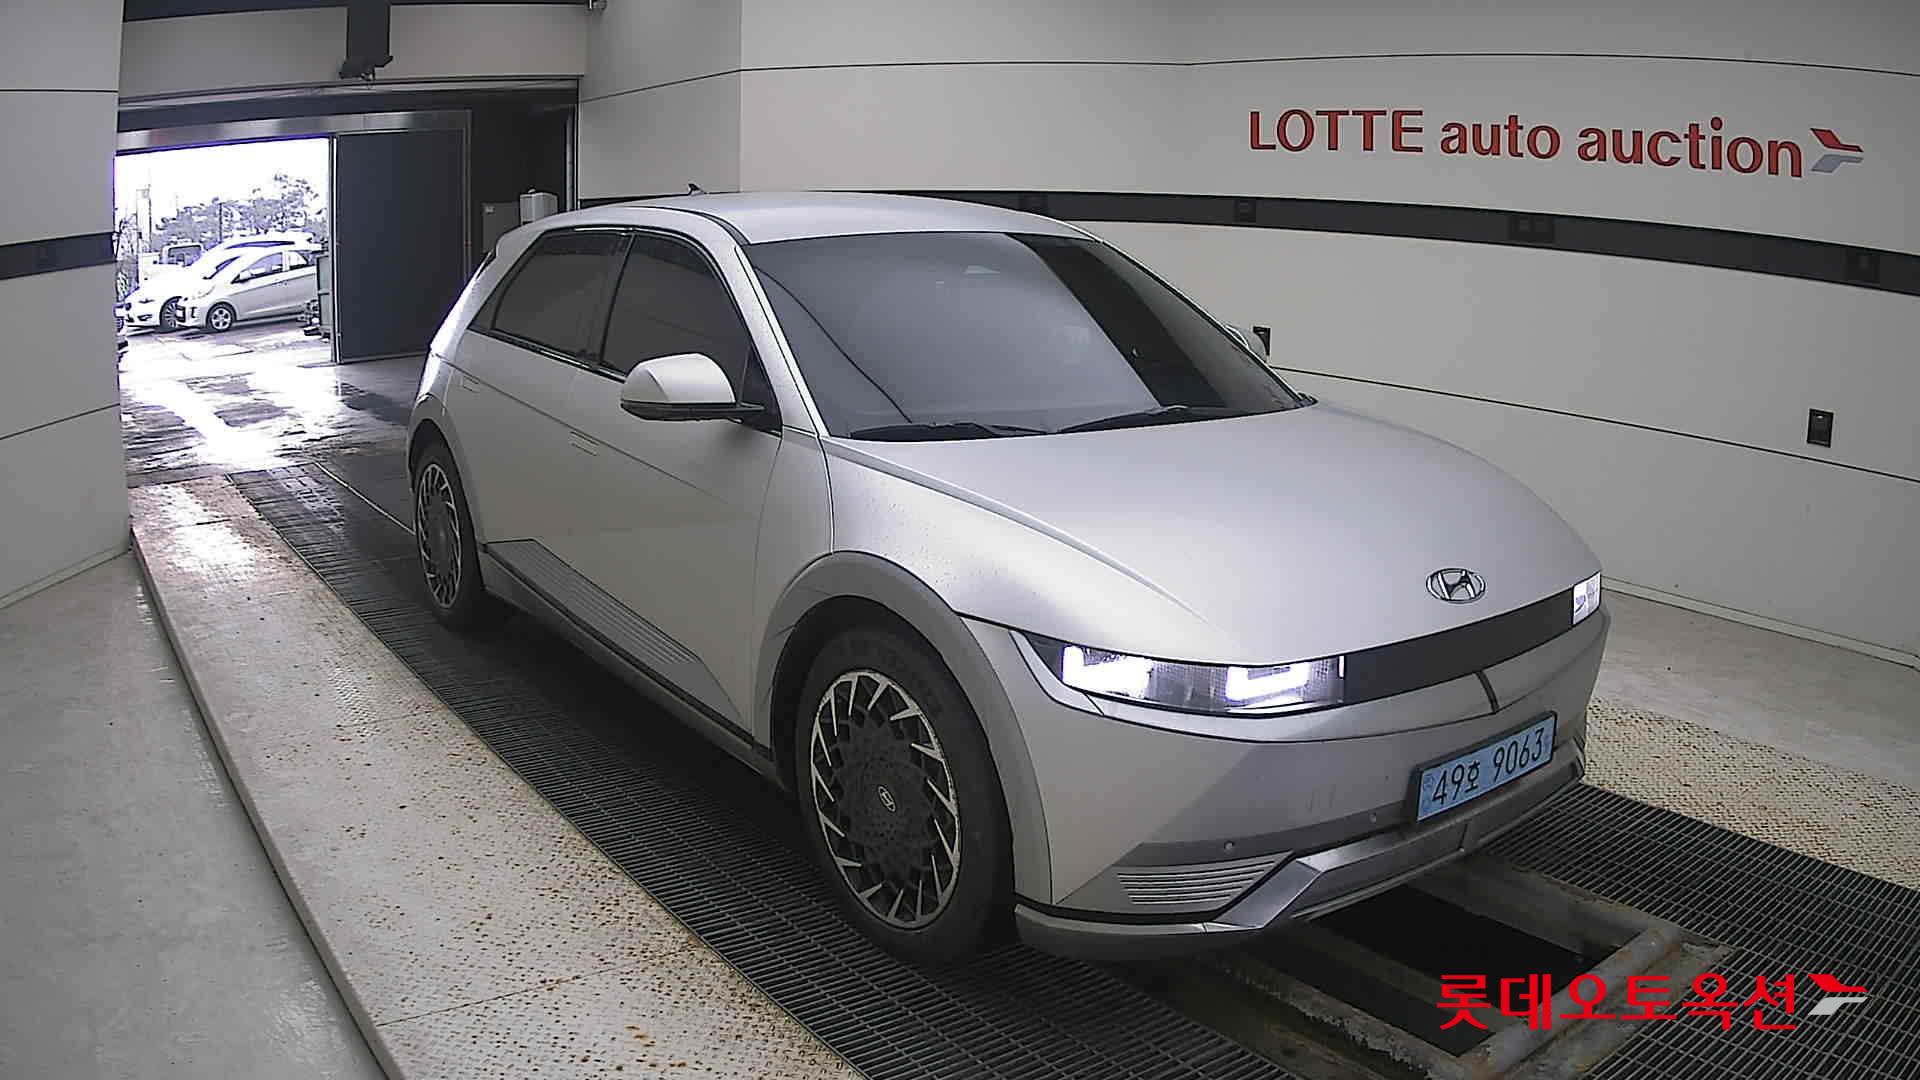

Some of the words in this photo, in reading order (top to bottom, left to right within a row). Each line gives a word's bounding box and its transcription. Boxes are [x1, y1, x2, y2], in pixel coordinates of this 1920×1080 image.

[1249, 109, 1424, 153] LOTTE
[1440, 115, 1561, 159] auto
[1577, 117, 1803, 178] auction
[1431, 760, 1481, 805] 49호
[1493, 727, 1545, 783] 9063
